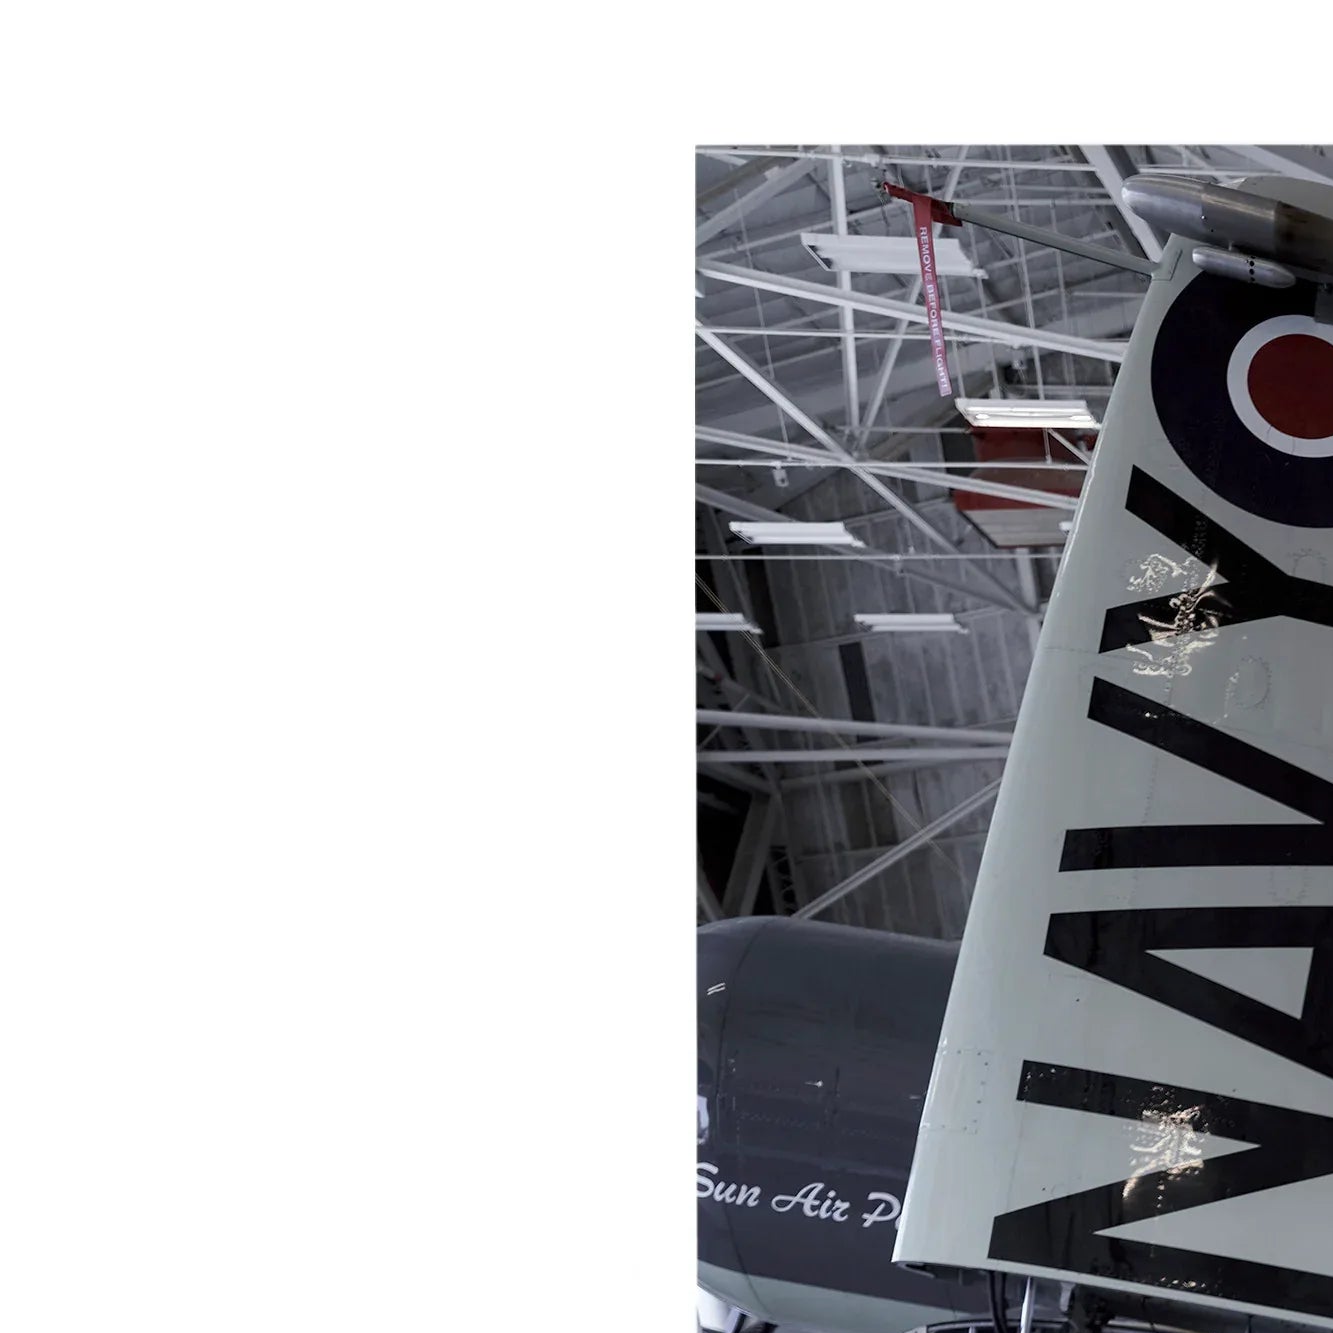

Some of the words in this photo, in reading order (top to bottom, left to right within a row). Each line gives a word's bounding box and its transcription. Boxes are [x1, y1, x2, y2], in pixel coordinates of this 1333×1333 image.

[919, 226, 933, 283] REMOVE
[926, 284, 940, 339] BEFORE
[697, 1162, 761, 1208] Sun
[771, 1183, 851, 1222] Air
[861, 1192, 902, 1230] P
